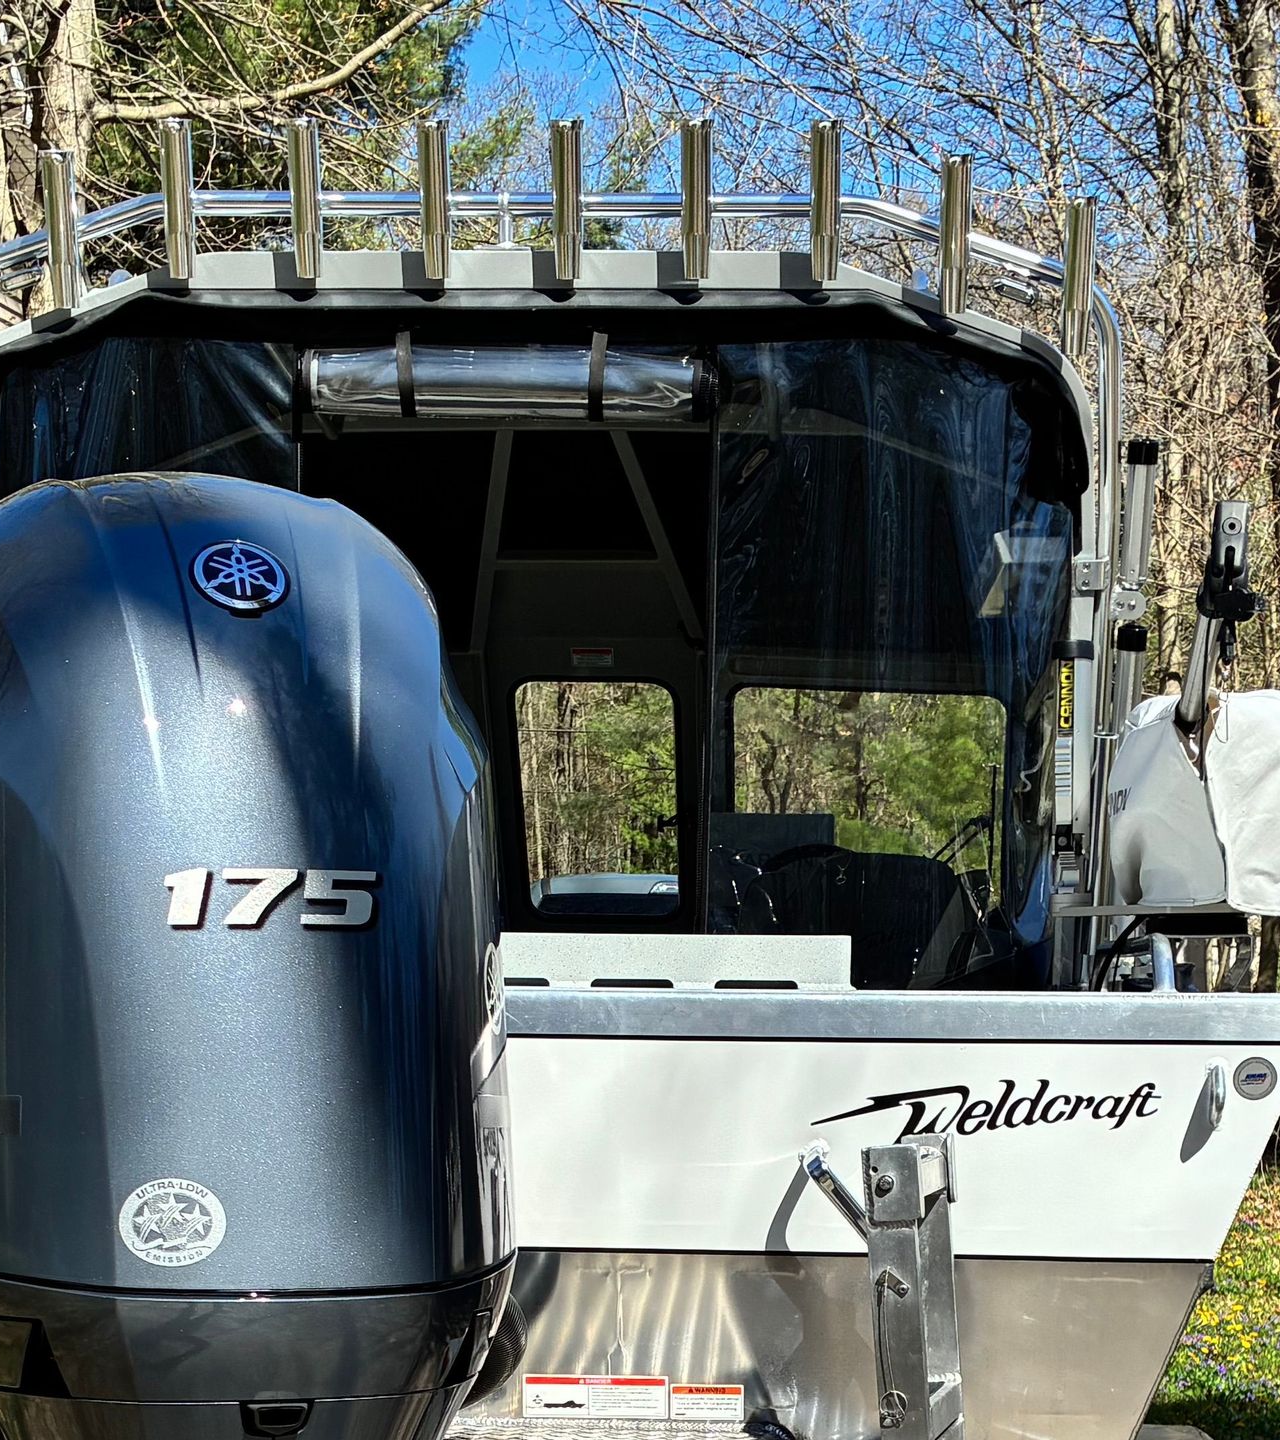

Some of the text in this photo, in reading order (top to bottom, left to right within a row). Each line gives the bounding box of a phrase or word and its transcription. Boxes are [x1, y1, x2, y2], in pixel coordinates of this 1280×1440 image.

[1060, 660, 1073, 729] CANNON
[163, 867, 377, 926] 175
[811, 1079, 1162, 1146] Weldcraft
[694, 1386, 727, 1395] WARNING
